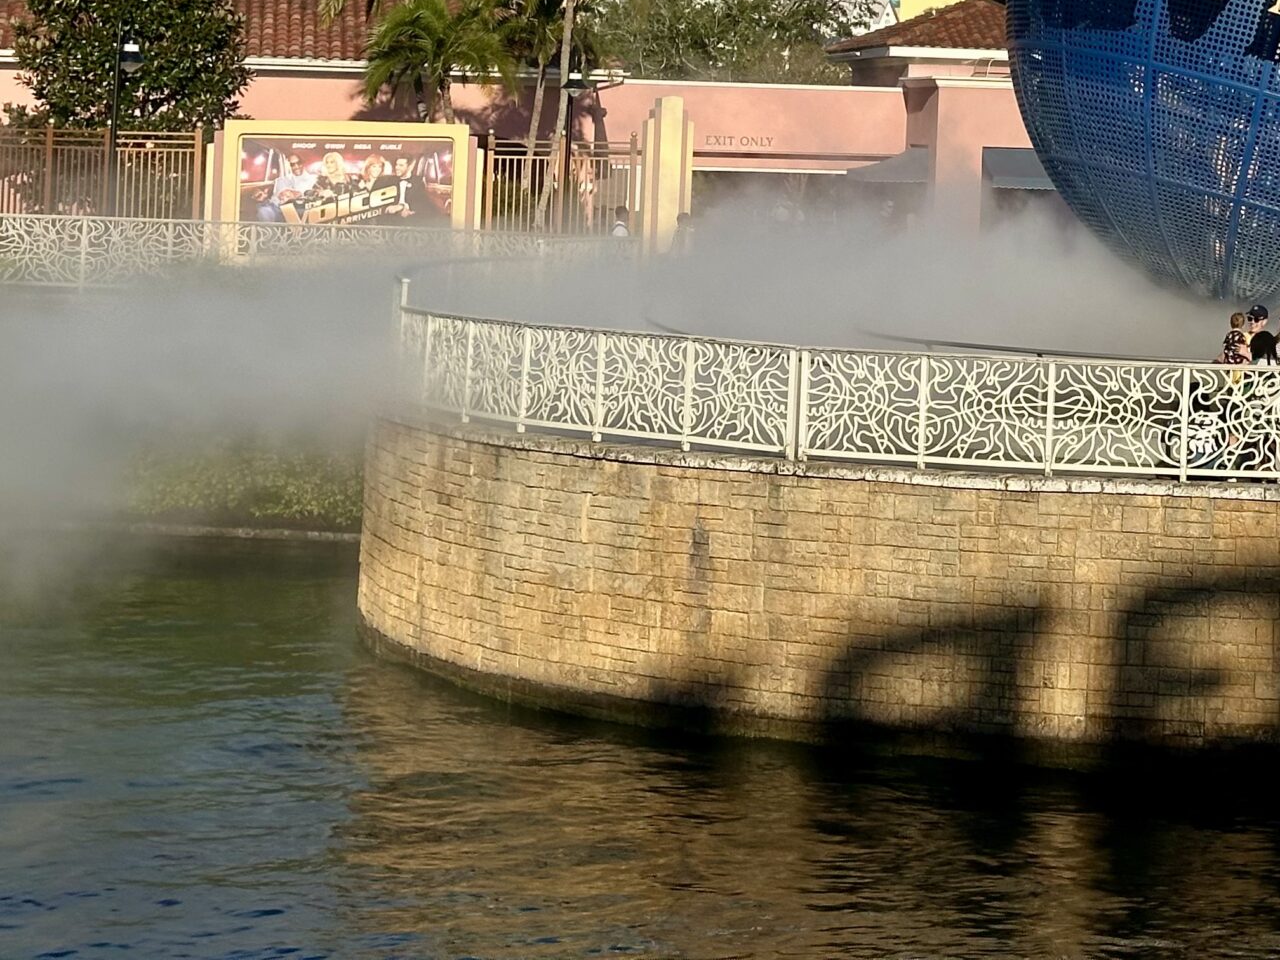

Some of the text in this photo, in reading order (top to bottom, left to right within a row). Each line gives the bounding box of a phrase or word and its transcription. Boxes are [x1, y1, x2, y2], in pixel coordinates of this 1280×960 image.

[705, 135, 773, 147] EXIT ONLY
[340, 210, 382, 225] ARRIVED!
